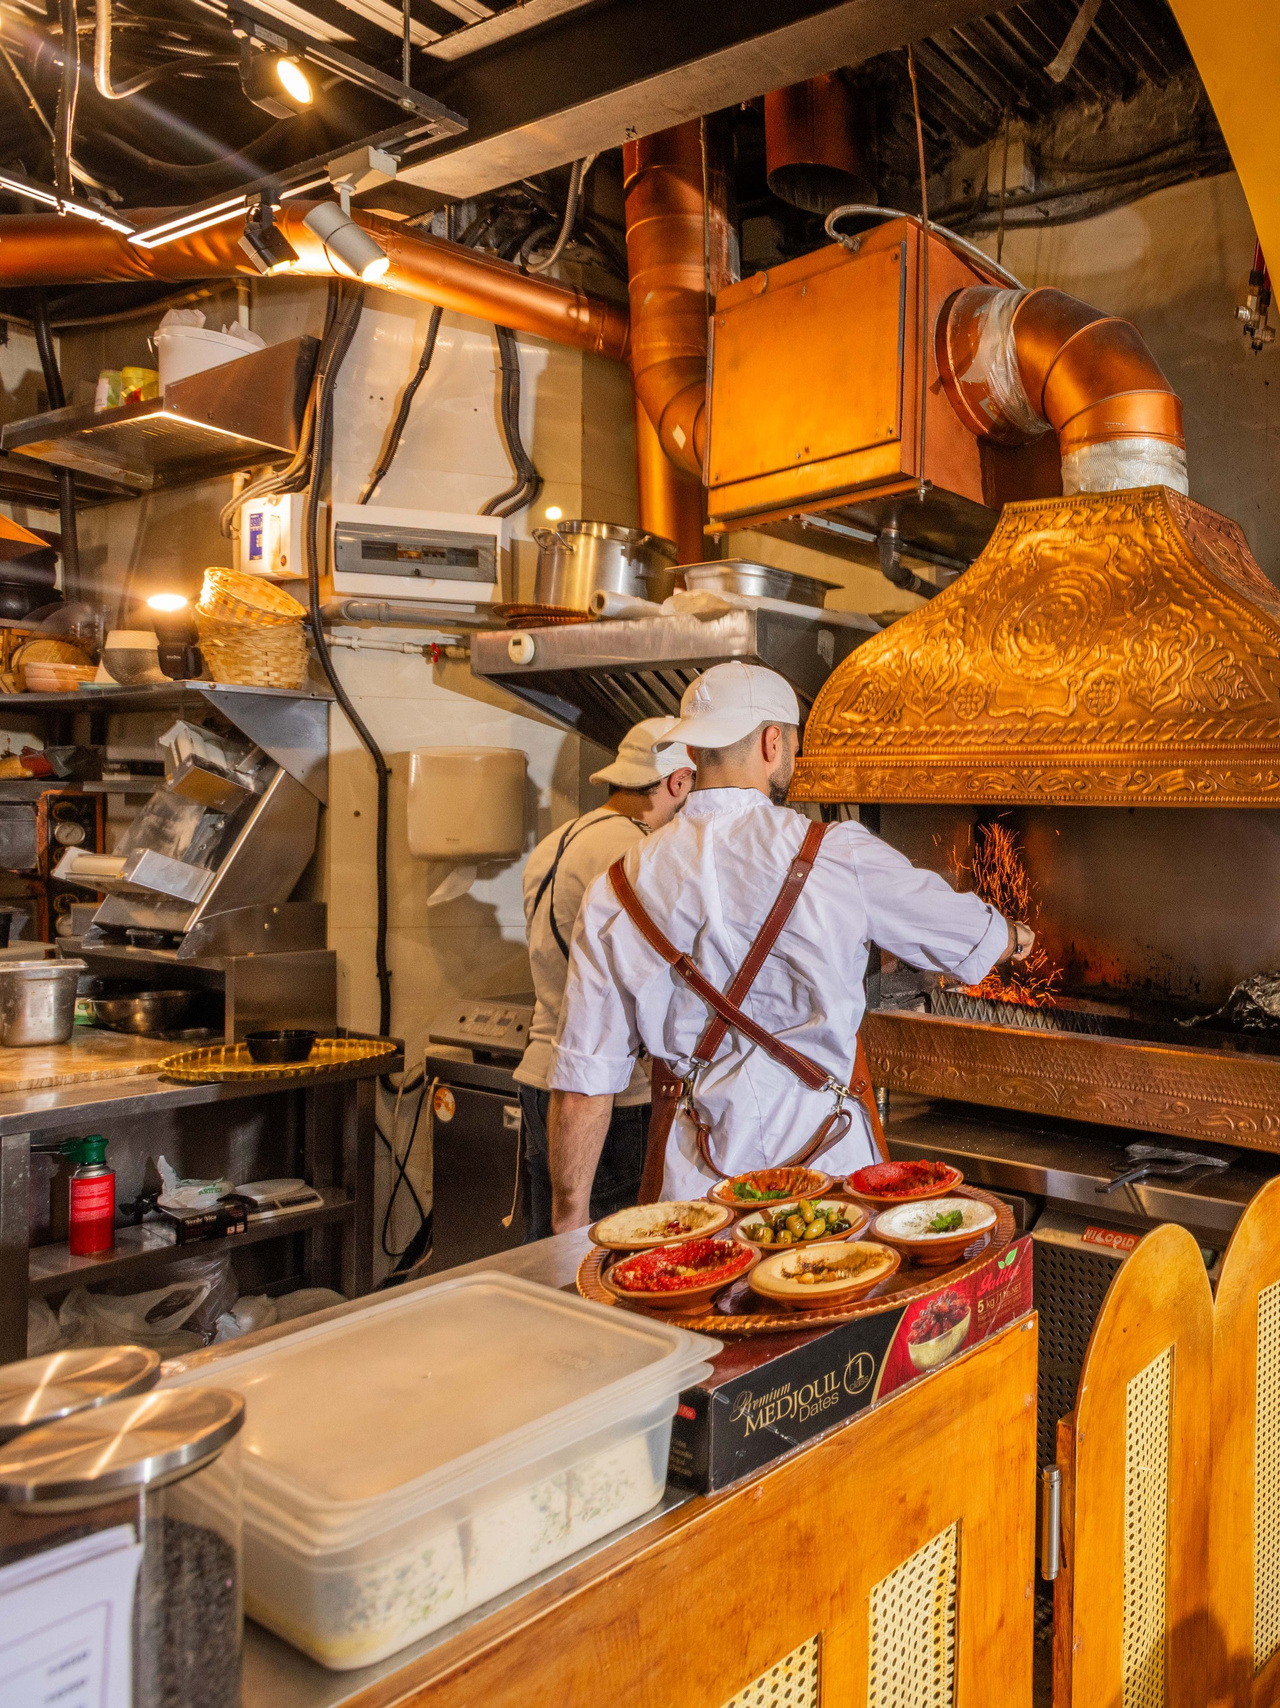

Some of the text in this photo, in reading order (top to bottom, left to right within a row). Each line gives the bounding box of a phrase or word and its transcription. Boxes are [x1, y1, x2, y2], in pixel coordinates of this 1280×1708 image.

[977, 1299, 985, 1314] 5
[729, 1382, 791, 1422] Premium
[744, 1370, 841, 1438] MEDJOUL
[799, 1391, 840, 1423] Dates
